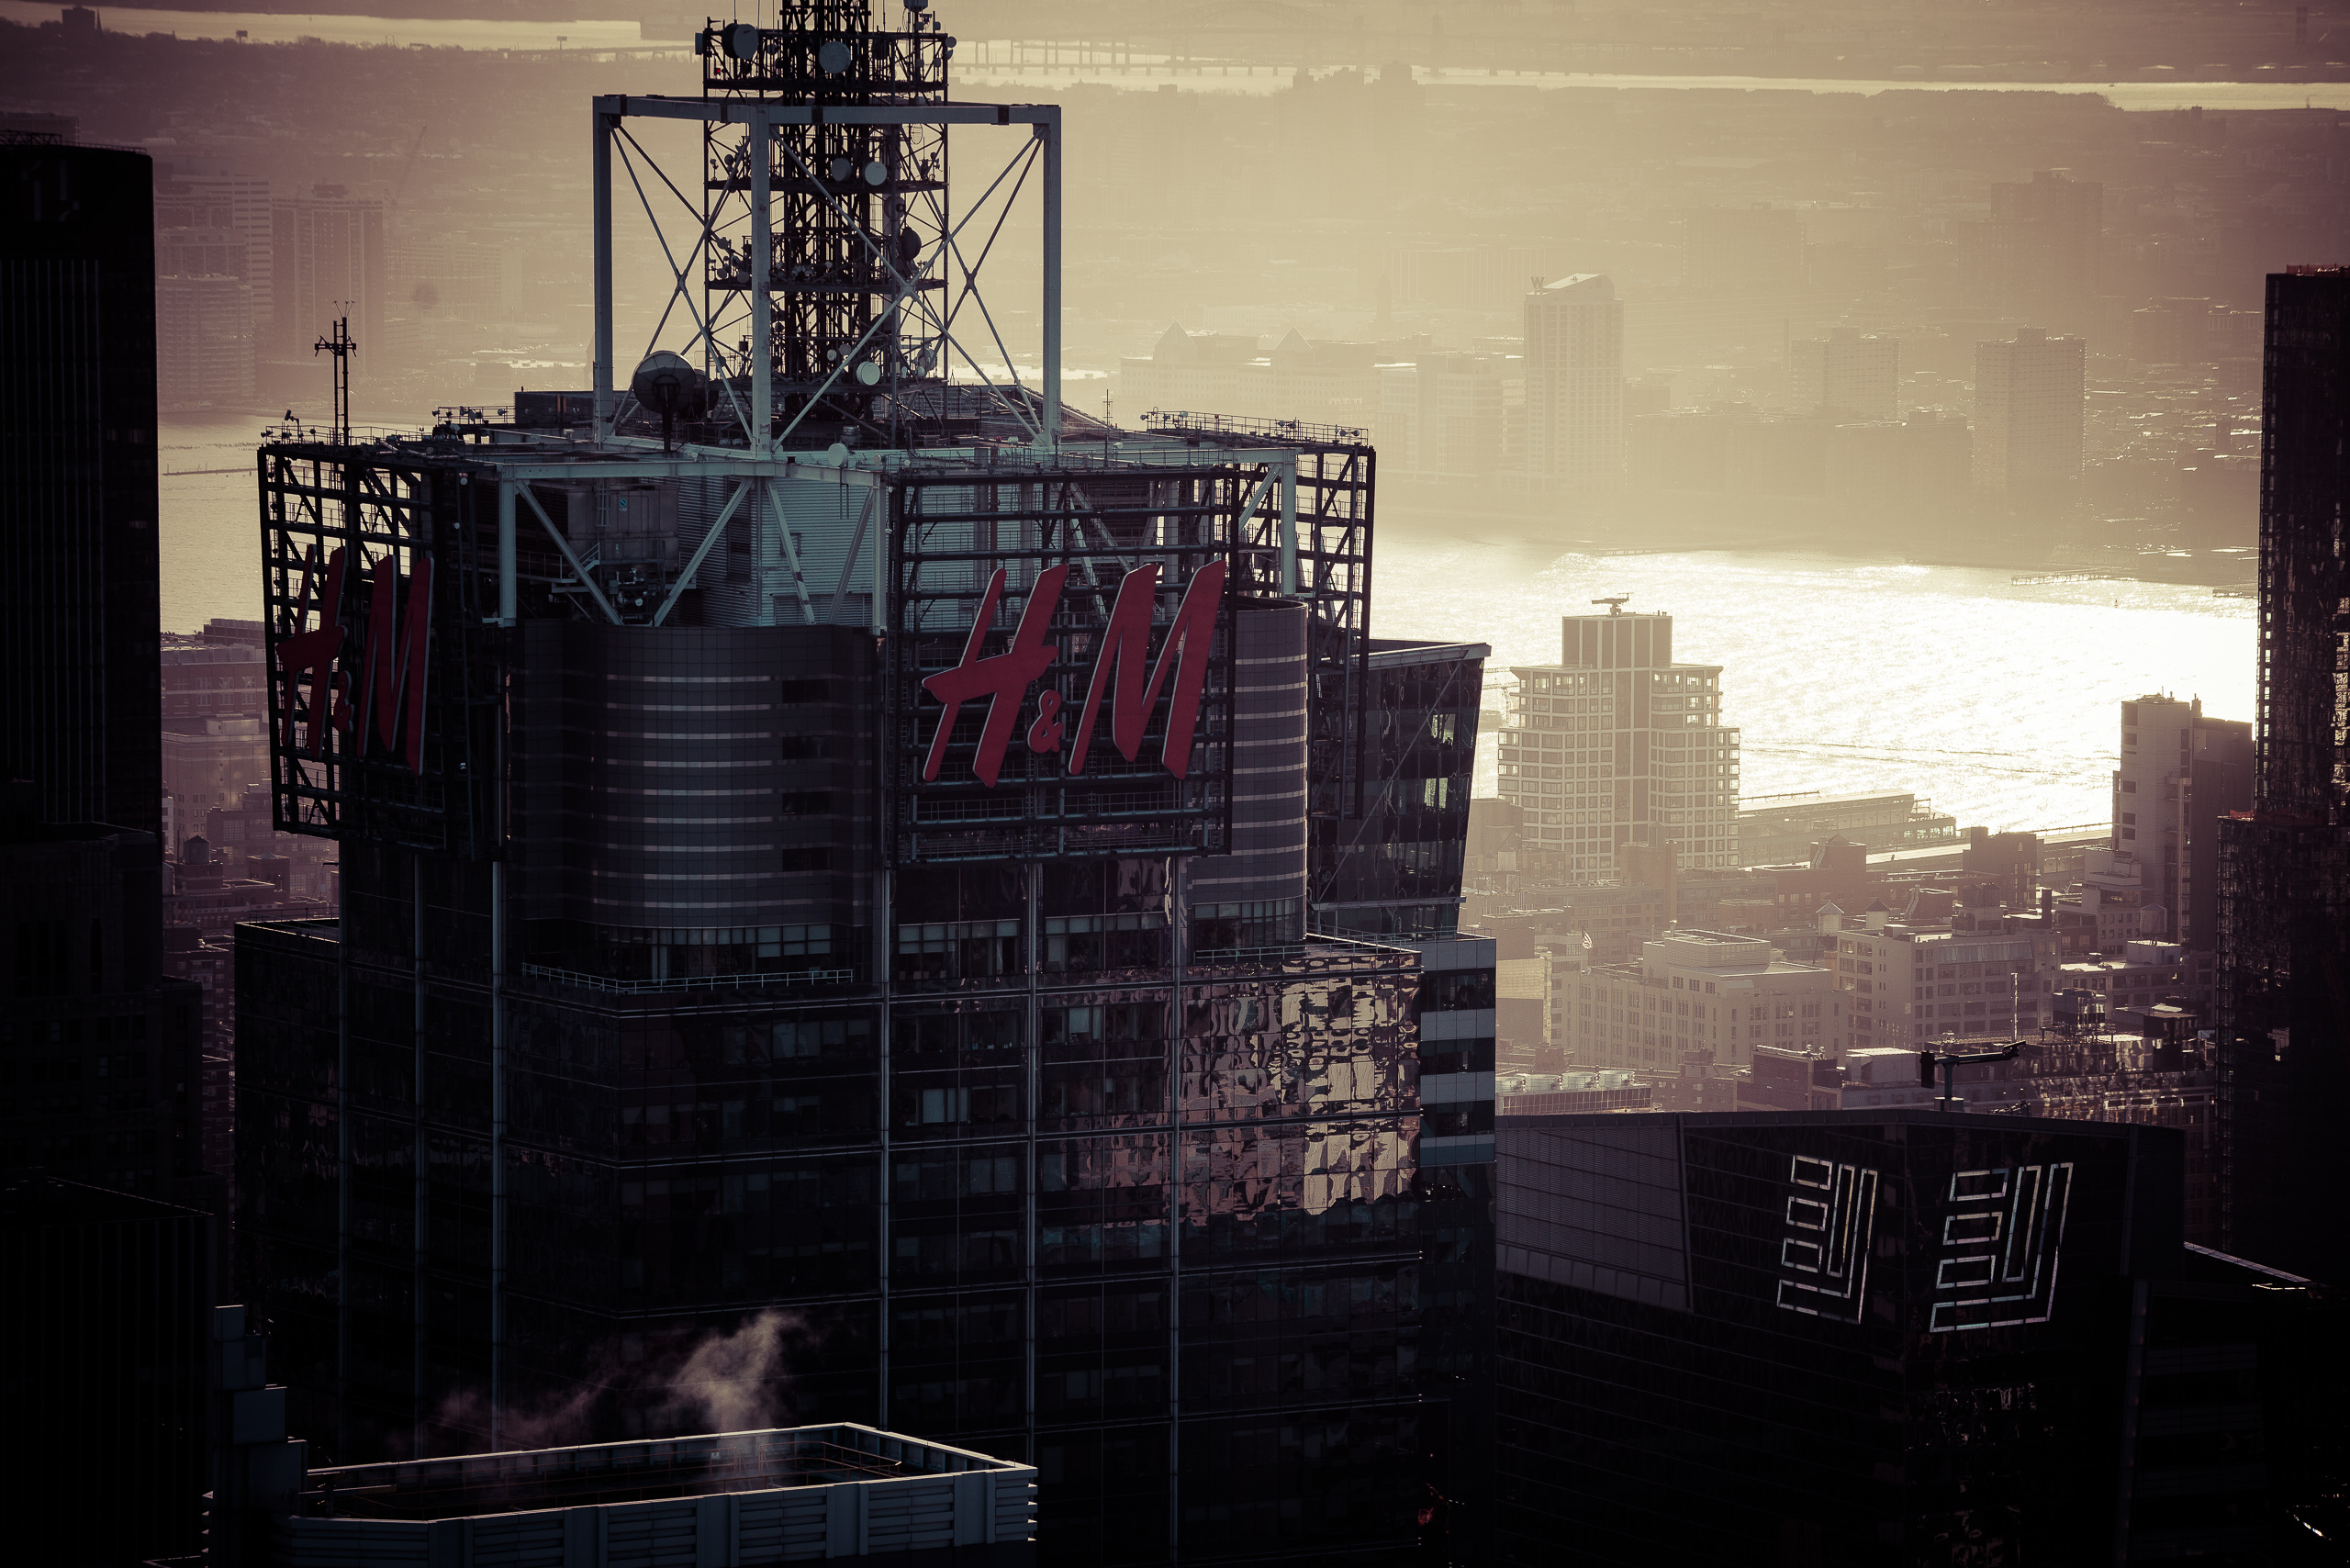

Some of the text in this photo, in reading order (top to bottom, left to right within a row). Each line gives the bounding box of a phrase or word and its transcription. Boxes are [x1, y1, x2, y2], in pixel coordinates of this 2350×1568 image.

[1530, 275, 1545, 289] W
[275, 543, 434, 778] H&M
[922, 559, 1225, 788] H&M
